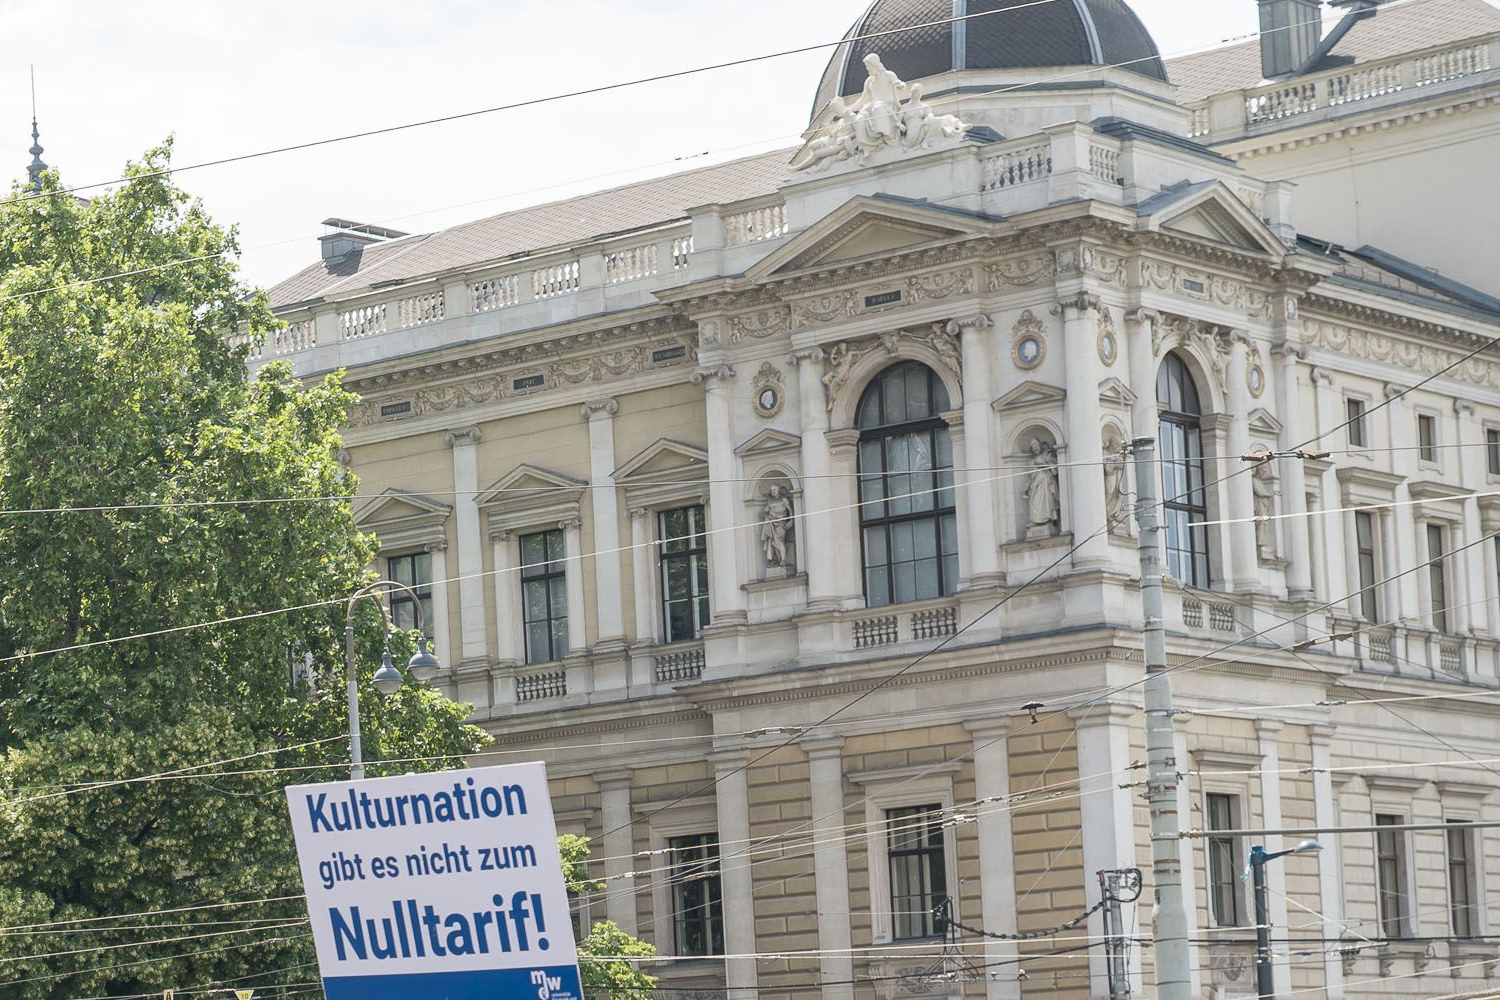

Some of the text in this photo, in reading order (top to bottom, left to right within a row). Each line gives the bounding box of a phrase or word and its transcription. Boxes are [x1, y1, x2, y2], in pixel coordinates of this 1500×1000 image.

[305, 777, 527, 833] Kulturnation
[319, 843, 537, 889] gibt es nicht zum
[329, 891, 550, 961] Nulltarif!
